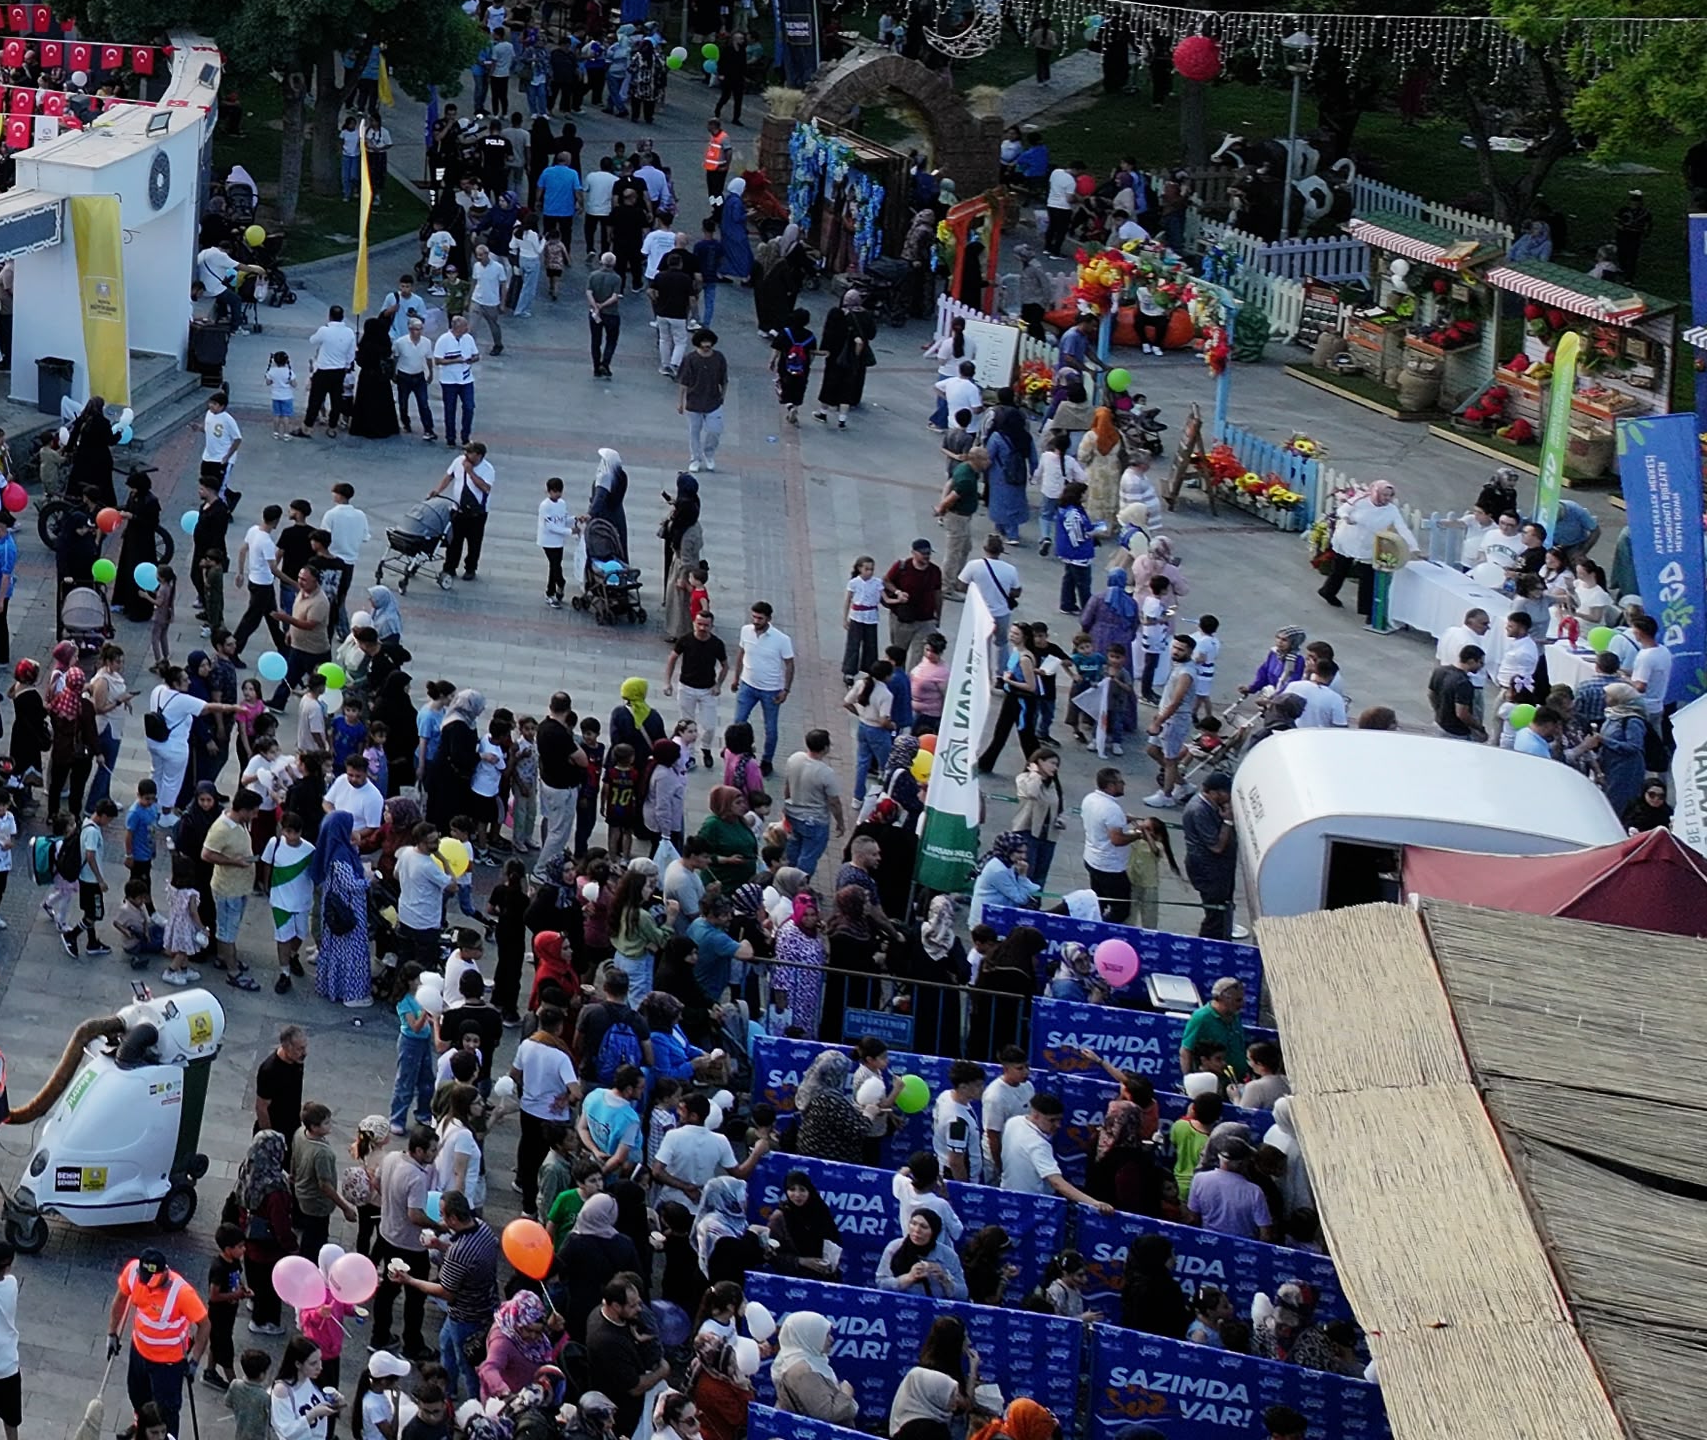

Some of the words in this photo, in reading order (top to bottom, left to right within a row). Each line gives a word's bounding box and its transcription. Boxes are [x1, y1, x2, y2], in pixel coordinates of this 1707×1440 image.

[1046, 1030, 1161, 1054] SAZIMDA
[1102, 1054, 1164, 1075] VAR!
[1108, 1366, 1251, 1405] SAZIMDA
[1178, 1398, 1254, 1429] VAR!
